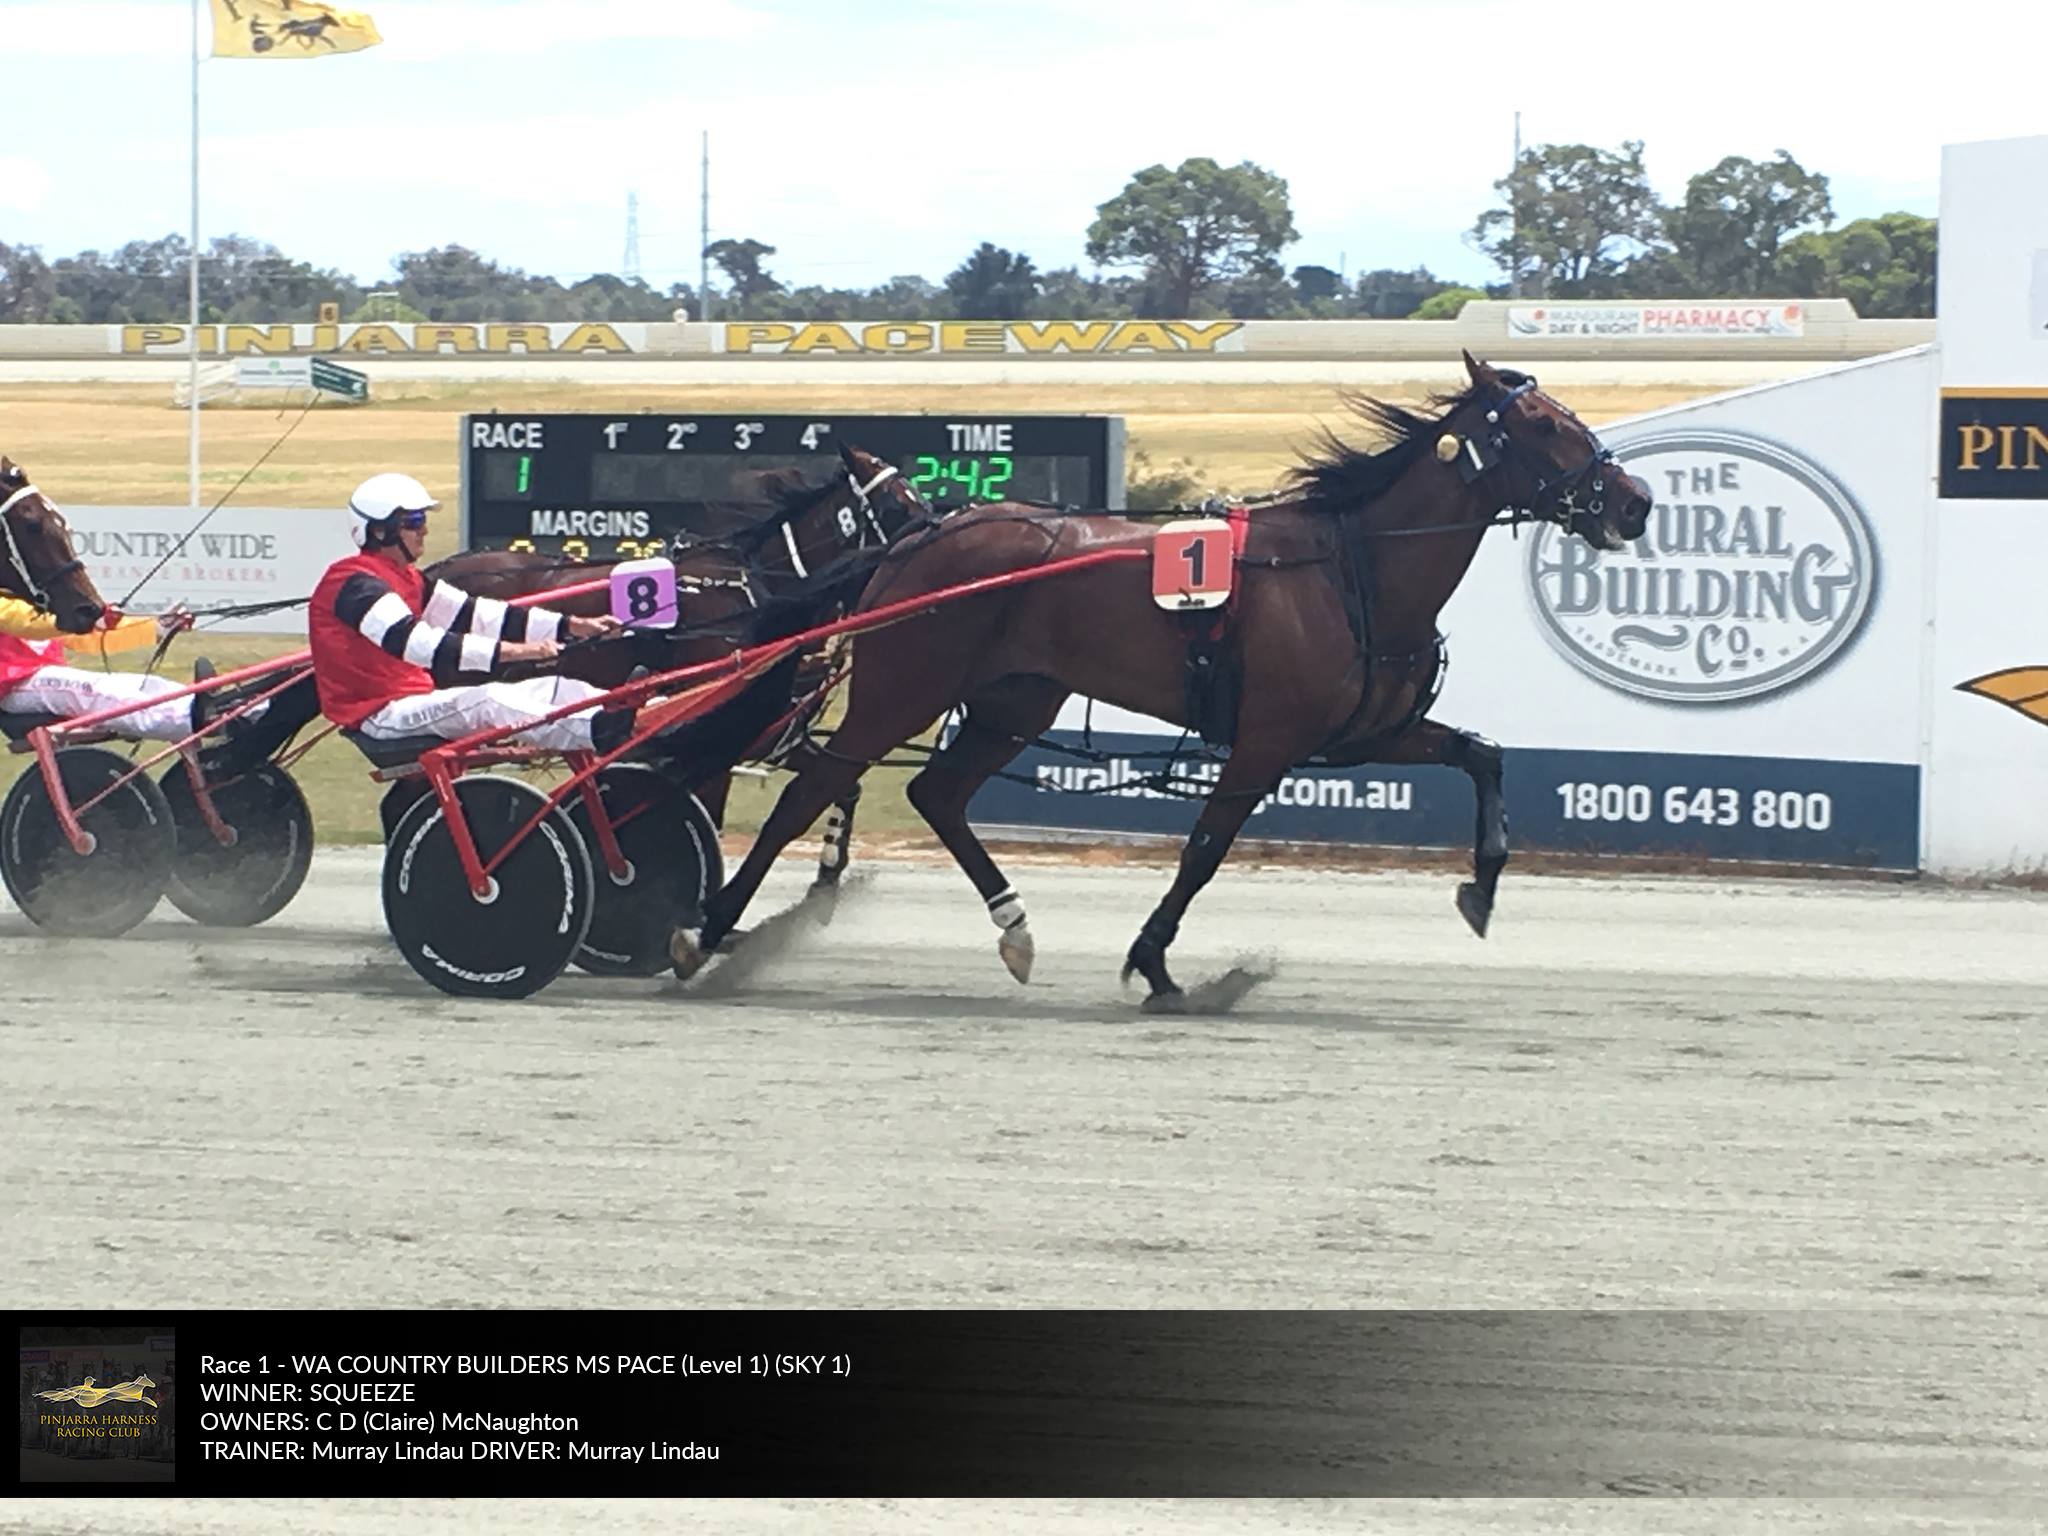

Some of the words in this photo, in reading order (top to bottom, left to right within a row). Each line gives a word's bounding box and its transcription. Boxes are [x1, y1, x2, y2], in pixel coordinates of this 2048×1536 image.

[1549, 323, 1576, 334] DAY
[1595, 322, 1640, 334] NIGHT
[1643, 309, 1770, 327] PHARMACY
[122, 324, 634, 353] PINJARRA
[724, 321, 1245, 354] PACEWAY
[472, 422, 544, 449] RACE
[946, 424, 1014, 452] TIME
[909, 456, 1014, 501] 2:42
[1664, 462, 1741, 497] THE
[531, 510, 650, 537] MARGINS
[837, 506, 857, 538] 8
[73, 531, 188, 558] OUNTRY
[200, 532, 278, 560] WIDE
[1180, 536, 1206, 588] 1
[180, 564, 278, 583] BROKERS
[1538, 542, 1857, 626] BUILDING
[626, 576, 659, 620] 8
[1575, 625, 1678, 677] TRADEMARK
[1556, 782, 1652, 823] 1800
[1662, 786, 1740, 826] 643
[1752, 789, 1832, 831] 800
[421, 943, 527, 983] CORIMA
